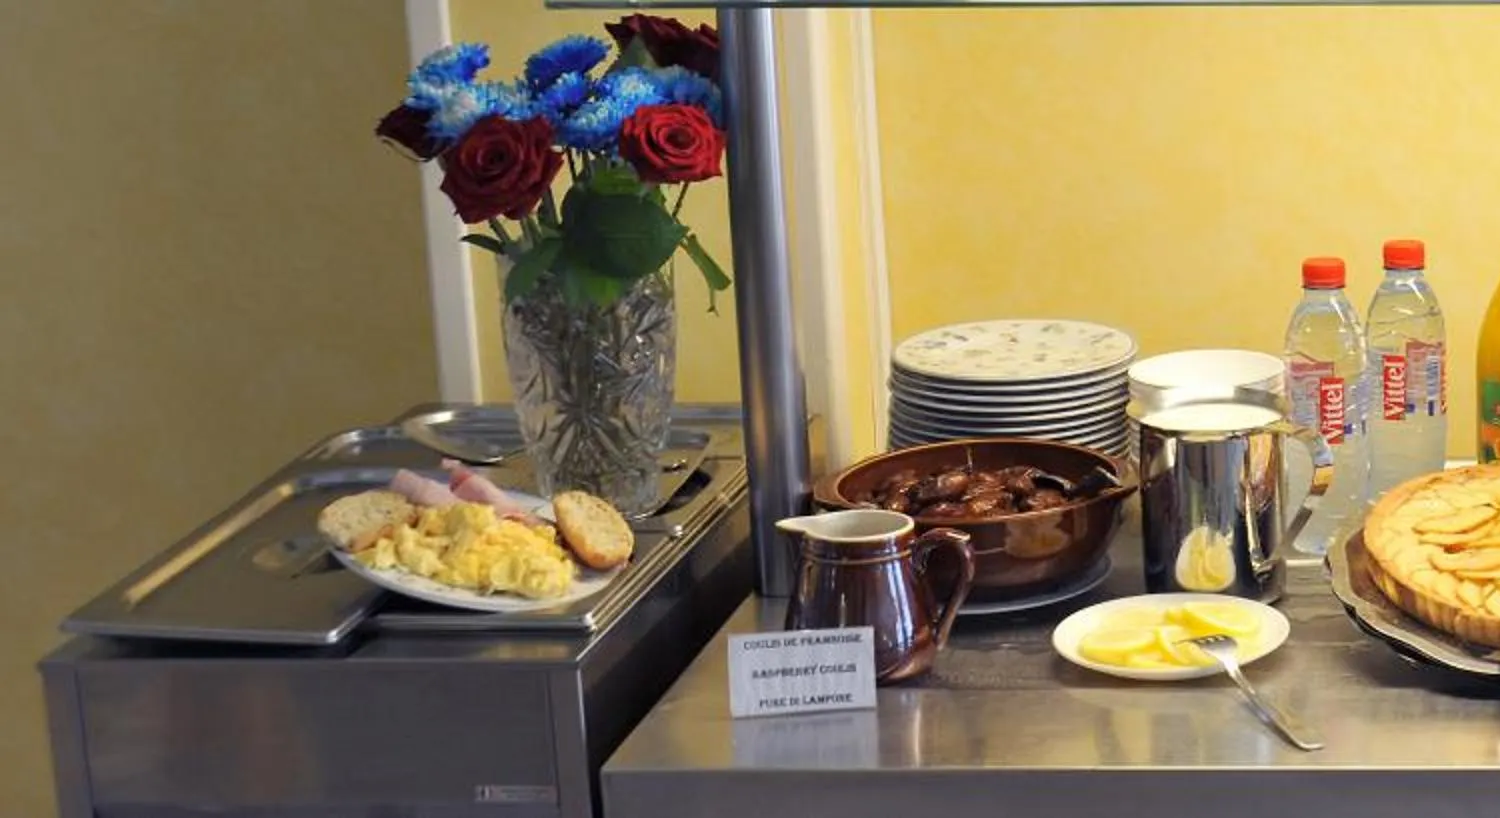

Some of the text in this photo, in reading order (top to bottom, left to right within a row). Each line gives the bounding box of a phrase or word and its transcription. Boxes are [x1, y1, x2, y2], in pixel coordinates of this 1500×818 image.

[784, 639, 798, 647] DE
[752, 664, 856, 679] RASPBERRY COULIS
[789, 697, 800, 706] DI
